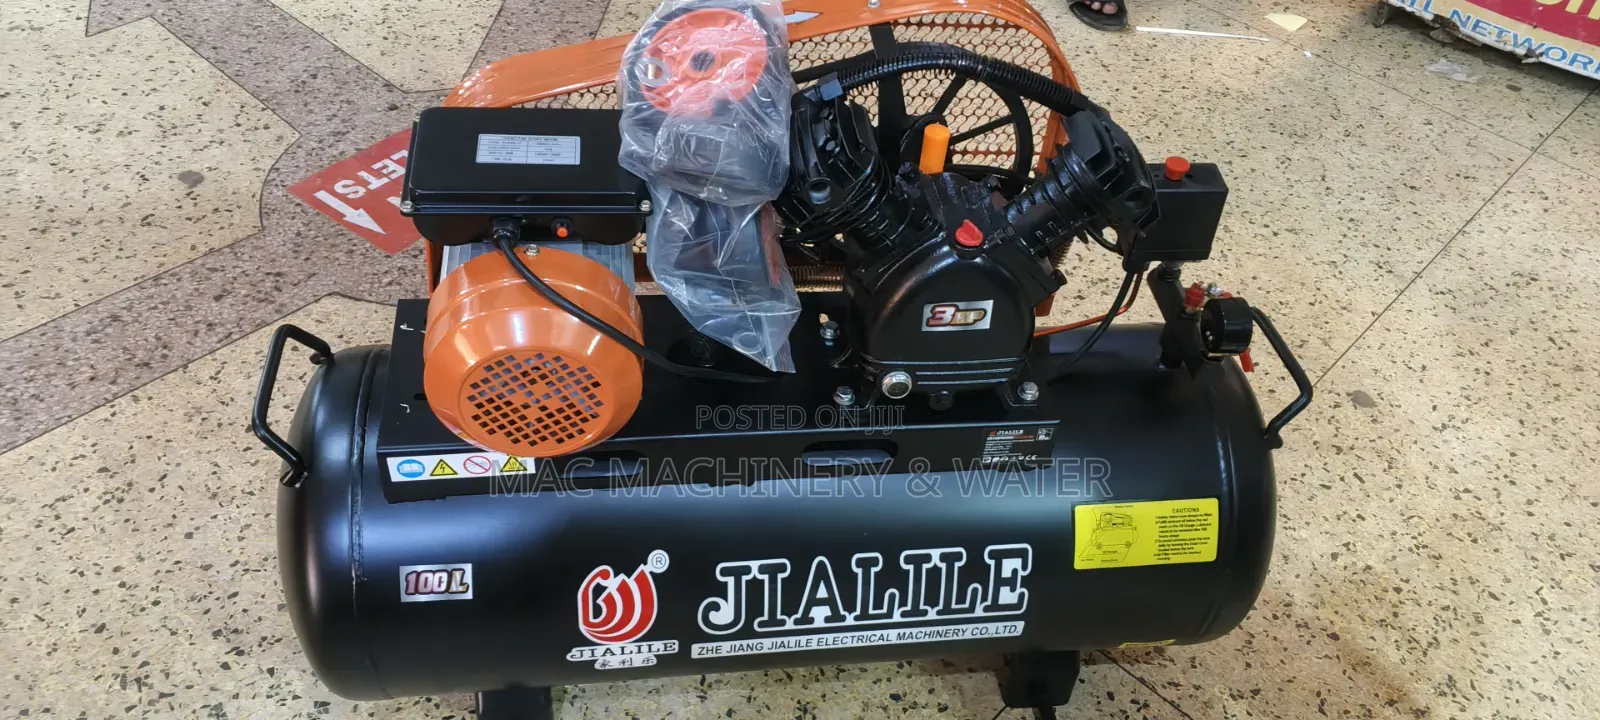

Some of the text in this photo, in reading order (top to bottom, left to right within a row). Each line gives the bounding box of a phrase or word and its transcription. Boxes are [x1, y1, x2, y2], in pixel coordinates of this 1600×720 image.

[697, 543, 1032, 635] JIALILE
[570, 642, 676, 659] JIALILE
[697, 645, 723, 656] ZHE
[726, 642, 764, 654] JIANG
[767, 637, 813, 651] JIALILE
[816, 632, 892, 647] ELECTRICAL
[895, 627, 969, 641] MACHINERY
